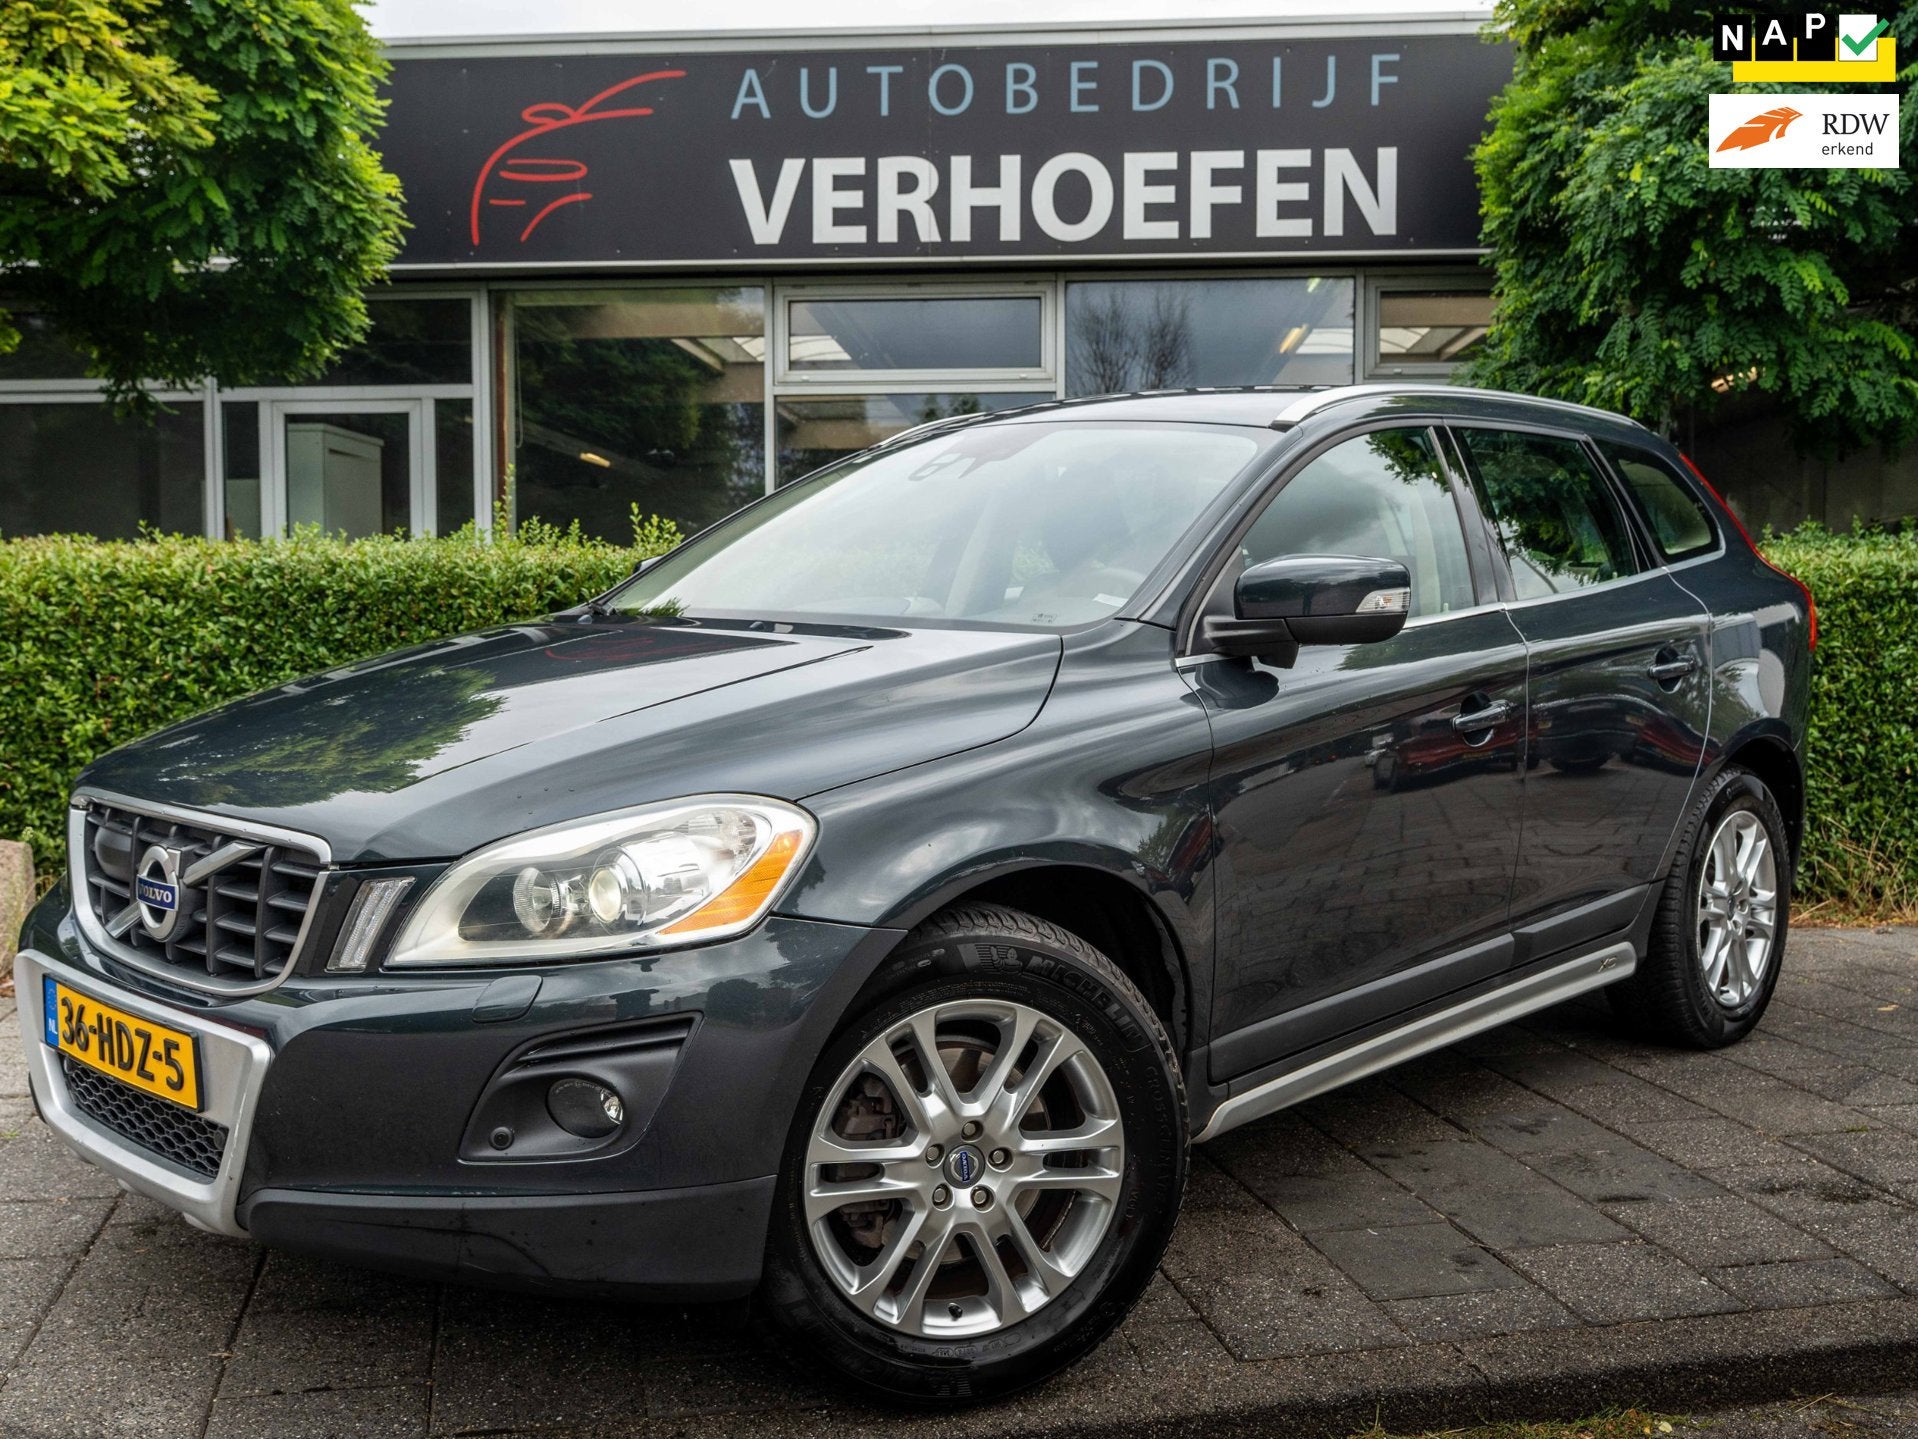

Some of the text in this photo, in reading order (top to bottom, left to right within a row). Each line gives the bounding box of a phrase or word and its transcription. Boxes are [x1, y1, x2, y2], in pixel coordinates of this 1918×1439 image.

[730, 54, 1402, 121] AUTOBEDRIJF
[728, 146, 1399, 246] VERHOEFEN
[60, 996, 185, 1092] 36-HDZ-5
[1026, 955, 1143, 1045] MICHELIN
